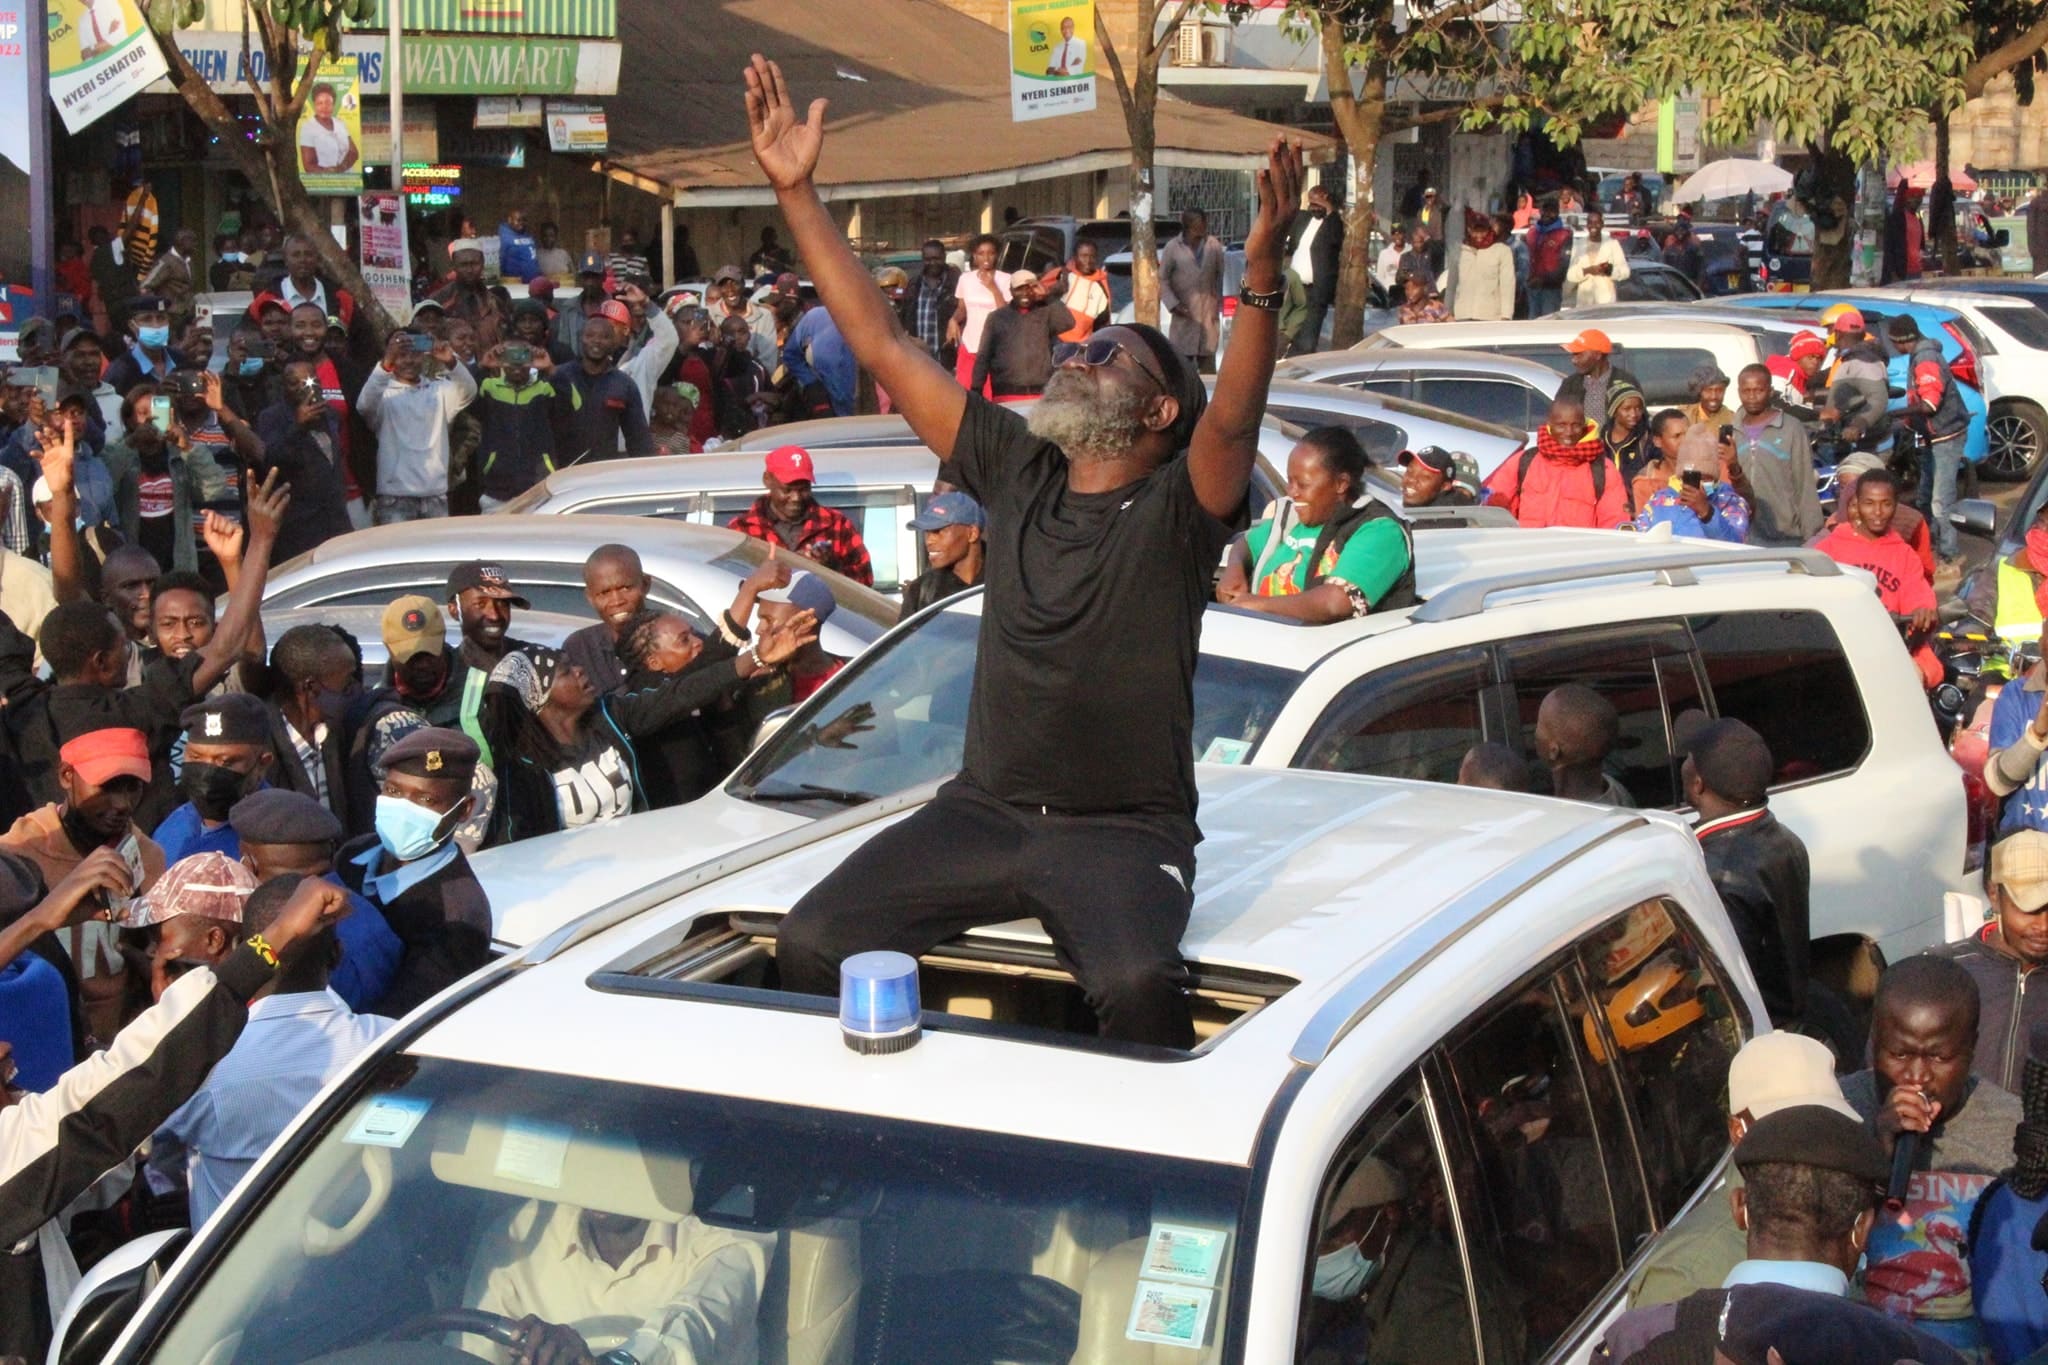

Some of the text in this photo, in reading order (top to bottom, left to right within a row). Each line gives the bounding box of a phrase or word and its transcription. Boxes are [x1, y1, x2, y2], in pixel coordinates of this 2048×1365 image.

[1030, 44, 1049, 53] UDA
[403, 42, 571, 85] WAYNMART
[62, 79, 97, 109] NYERI
[95, 45, 147, 86] SENATOR
[1021, 82, 1090, 102] NYERI SENATOR
[402, 168, 460, 178] ACCESSORIES
[365, 272, 406, 285] GOSHEN
